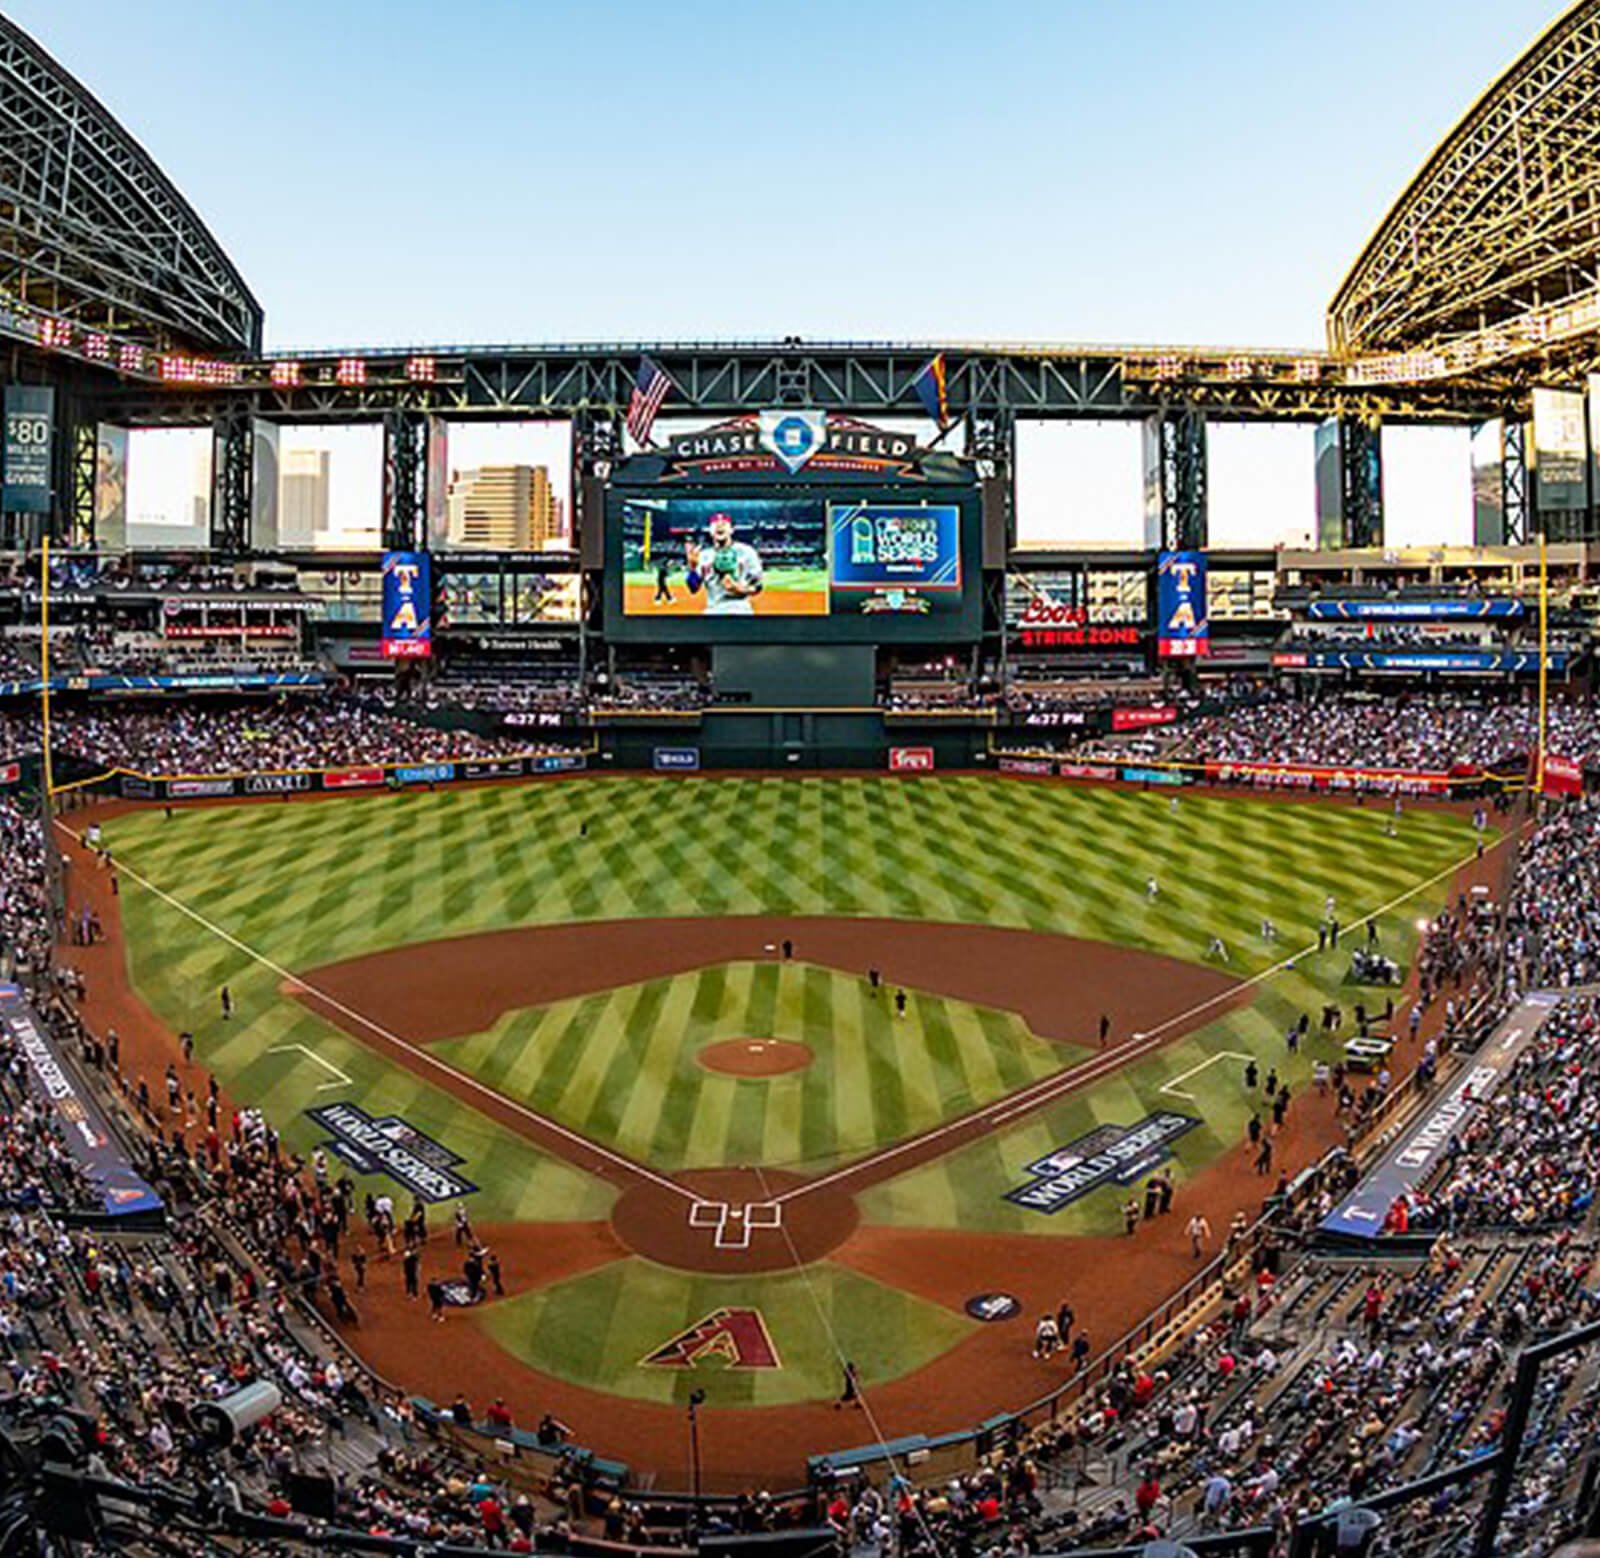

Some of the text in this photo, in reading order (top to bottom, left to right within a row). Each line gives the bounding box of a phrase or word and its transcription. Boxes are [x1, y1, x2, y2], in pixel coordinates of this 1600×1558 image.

[8, 421, 48, 444] $80
[677, 434, 909, 457] CHASE FIELD
[876, 531, 938, 547] WORLD
[877, 545, 939, 562] SERIES
[390, 603, 417, 629] A
[1022, 598, 1087, 624] Coors
[1168, 602, 1195, 629] A
[1021, 628, 1139, 645] STRIKE ZONE
[539, 713, 561, 726] PM
[1062, 712, 1085, 725] PM
[321, 1104, 402, 1153] WORLD
[377, 1147, 462, 1198] SERIES
[1019, 1156, 1119, 1206] WORLD
[1104, 1114, 1188, 1160] SERIES
